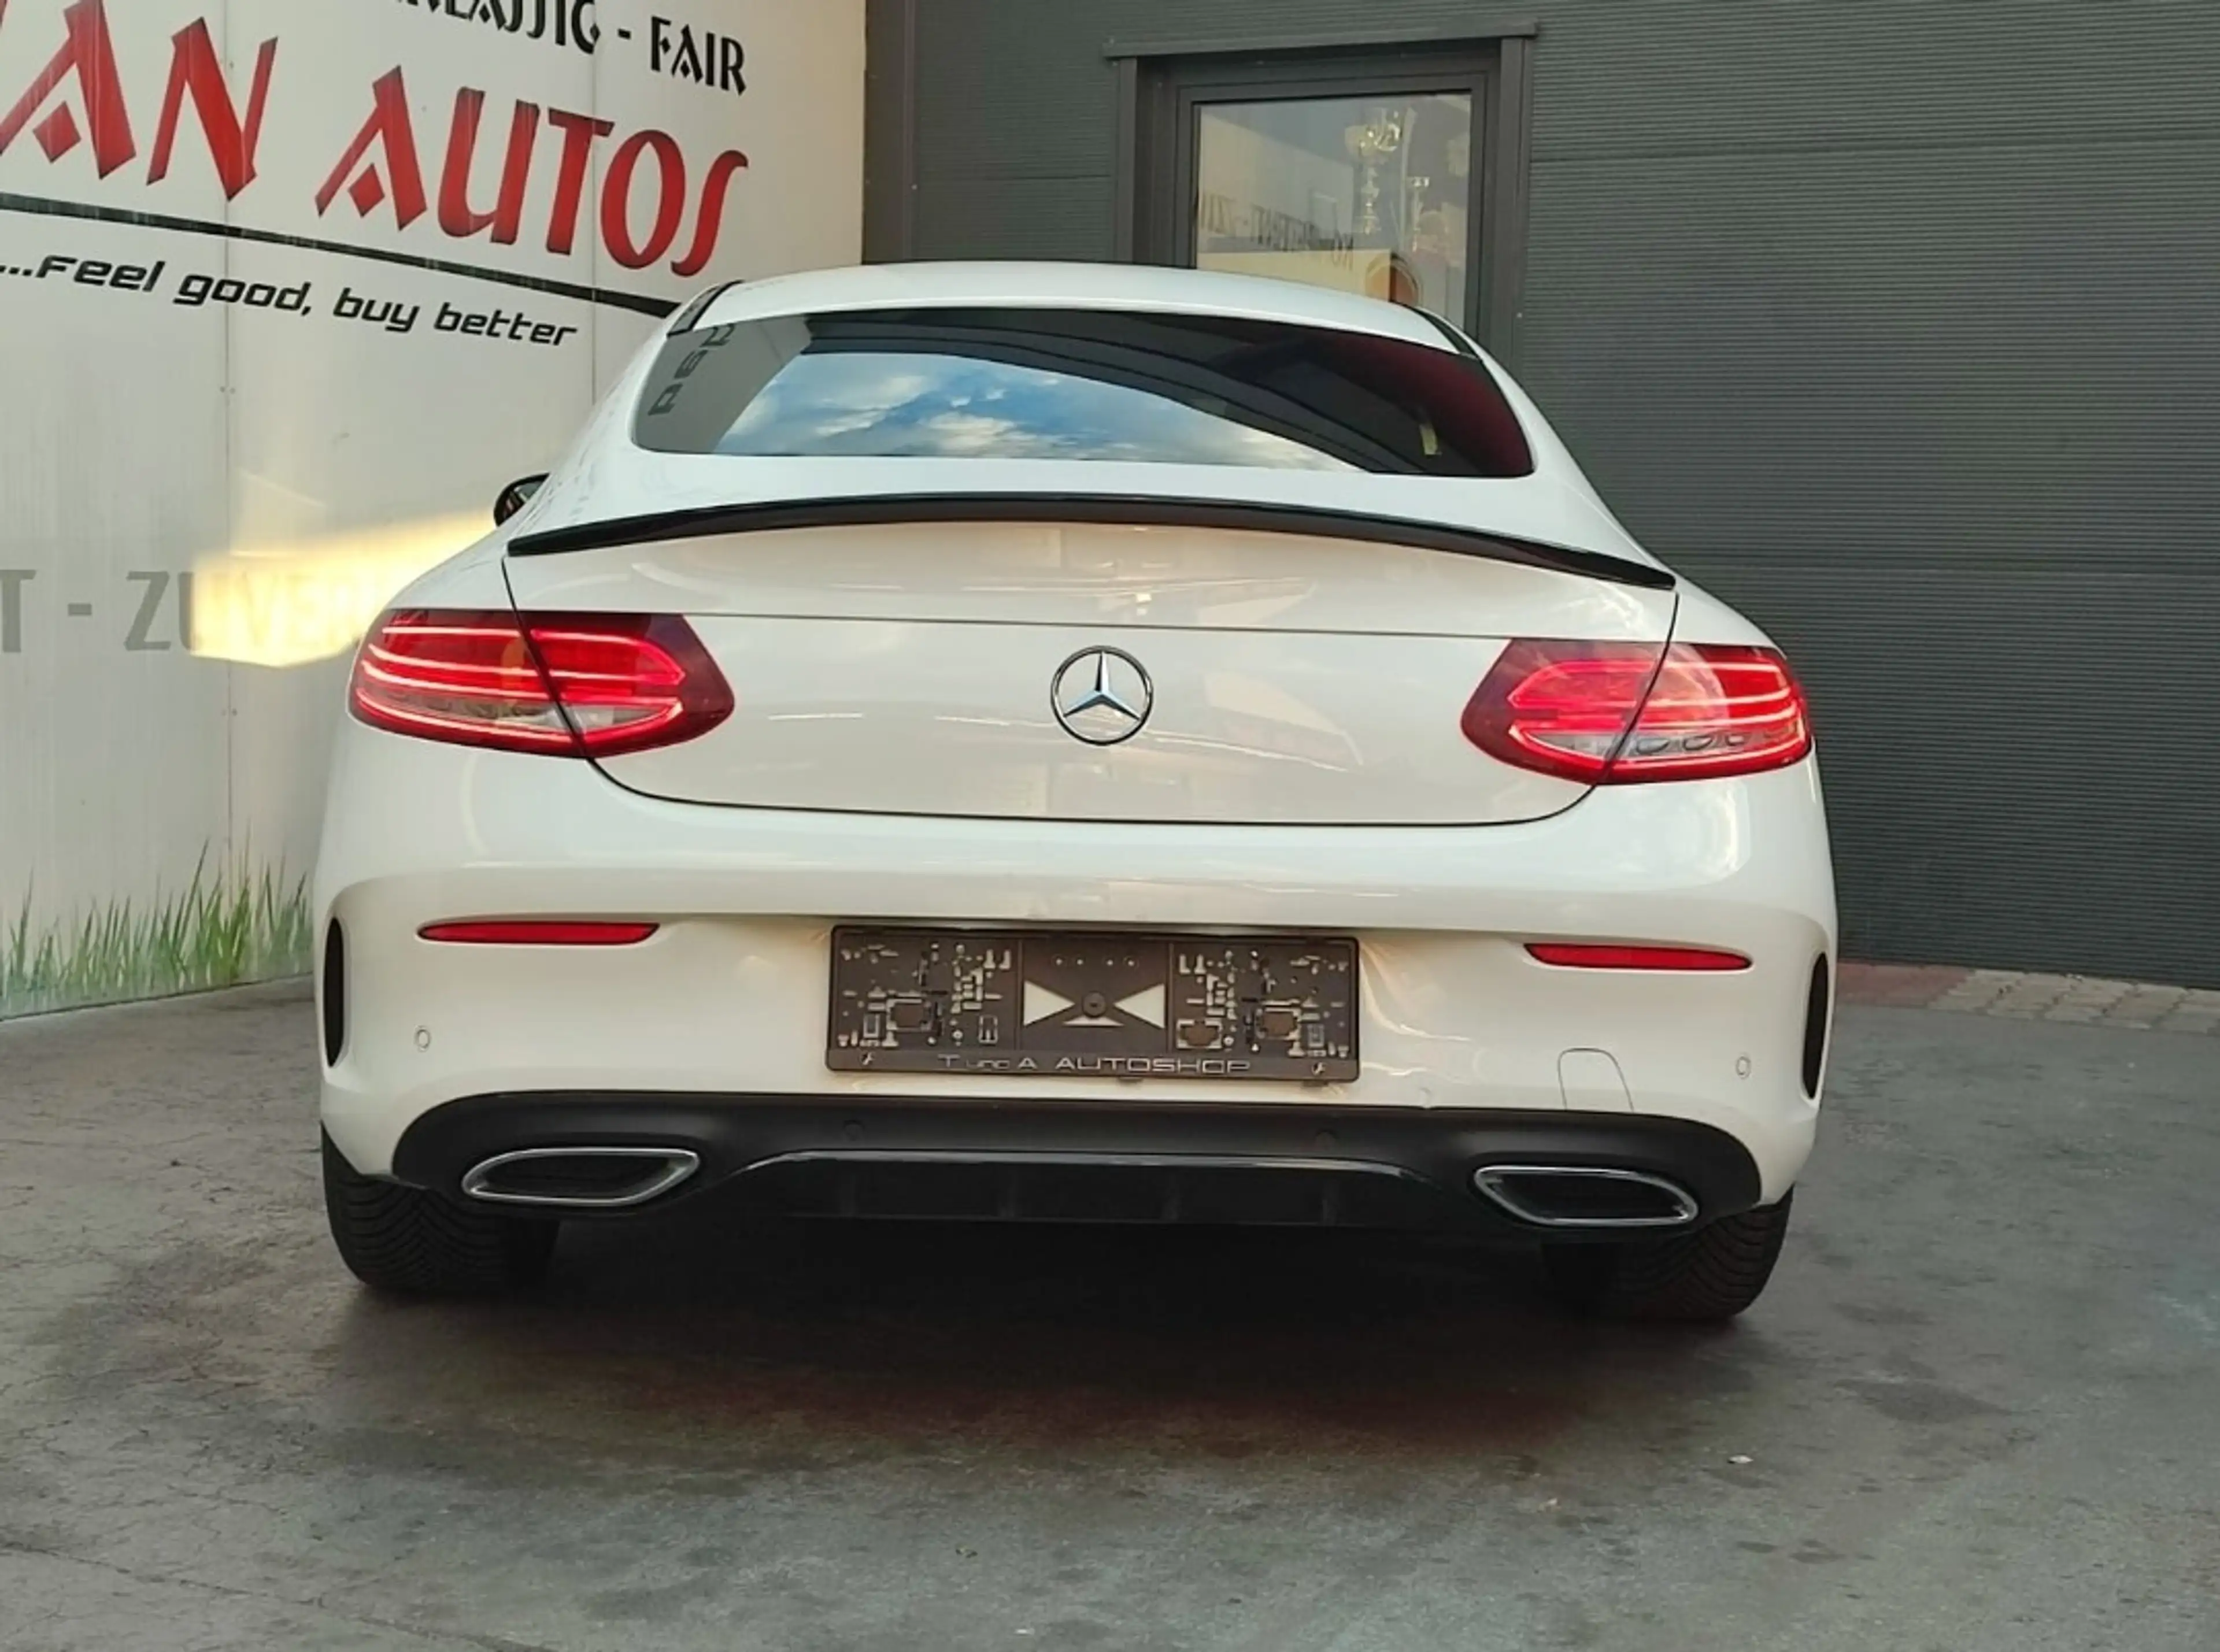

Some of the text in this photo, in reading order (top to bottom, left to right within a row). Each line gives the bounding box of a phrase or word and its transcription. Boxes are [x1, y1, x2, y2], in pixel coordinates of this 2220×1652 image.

[650, 16, 746, 95] FAIR
[0, 0, 748, 277] AN AUTOS
[173, 275, 311, 316] good,
[333, 287, 419, 333] buy
[434, 302, 577, 346] better
[1055, 1057, 1250, 1074] AUTOSHOP
